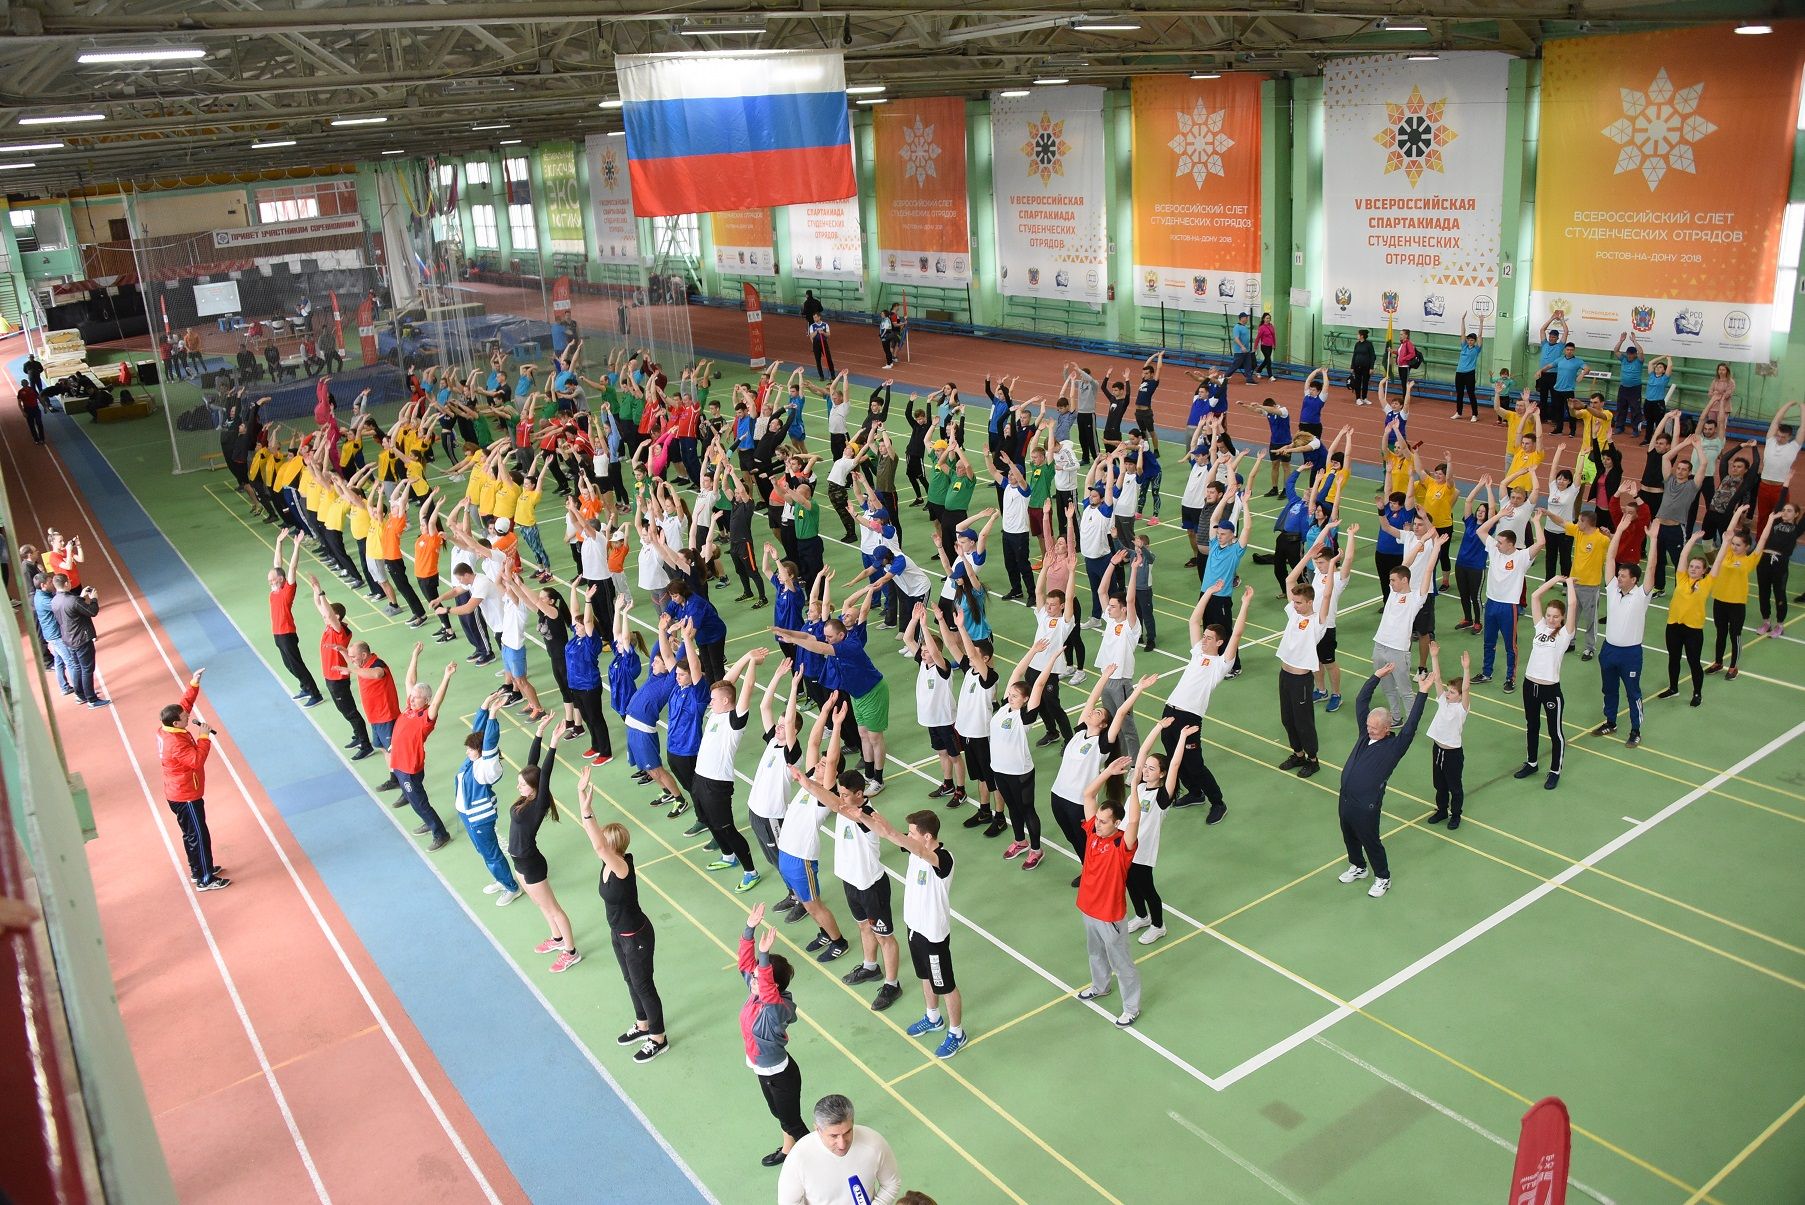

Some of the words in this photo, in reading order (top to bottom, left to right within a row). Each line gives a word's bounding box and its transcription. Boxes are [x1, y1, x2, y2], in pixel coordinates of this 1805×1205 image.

[1016, 193, 1084, 206] ВСЕРОССИЙСКАЯ
[1355, 199, 1364, 210] V
[1365, 195, 1476, 211] ВСЕРОССИЙСКАЯ
[1154, 203, 1224, 214] ВСЕРОССИЙСКИЙ
[1226, 205, 1248, 215] СЛЕТ
[1018, 210, 1075, 221] СПАРТАКИАДА
[1574, 210, 1690, 225] ВСЕРОССИЙСКИЙ
[1695, 213, 1735, 225] СЛЕТ
[1150, 216, 1211, 227] СТУДЕНЧЕСКИХ
[1213, 218, 1252, 228] ОТРЯДОВ
[1368, 217, 1460, 231] СПАРТАКИАДА
[1018, 224, 1076, 235] СТУДЕНЧЕСКИХ
[1565, 227, 1668, 242] СТУДЕНЧЕСКИХ
[1673, 231, 1743, 244] ОТРЯДОВ
[231, 231, 259, 241] ПРИВЕТ
[1368, 235, 1460, 249] СТУДЕНЧЕСКИХ
[1030, 238, 1065, 250] ОТРЯДОВ
[1386, 253, 1441, 267] ОТРЯДОВ
[1596, 251, 1676, 263] РОСТОВ-НА-ДОНУ
[1681, 254, 1702, 263] 2018
[1503, 265, 1511, 276] 12
